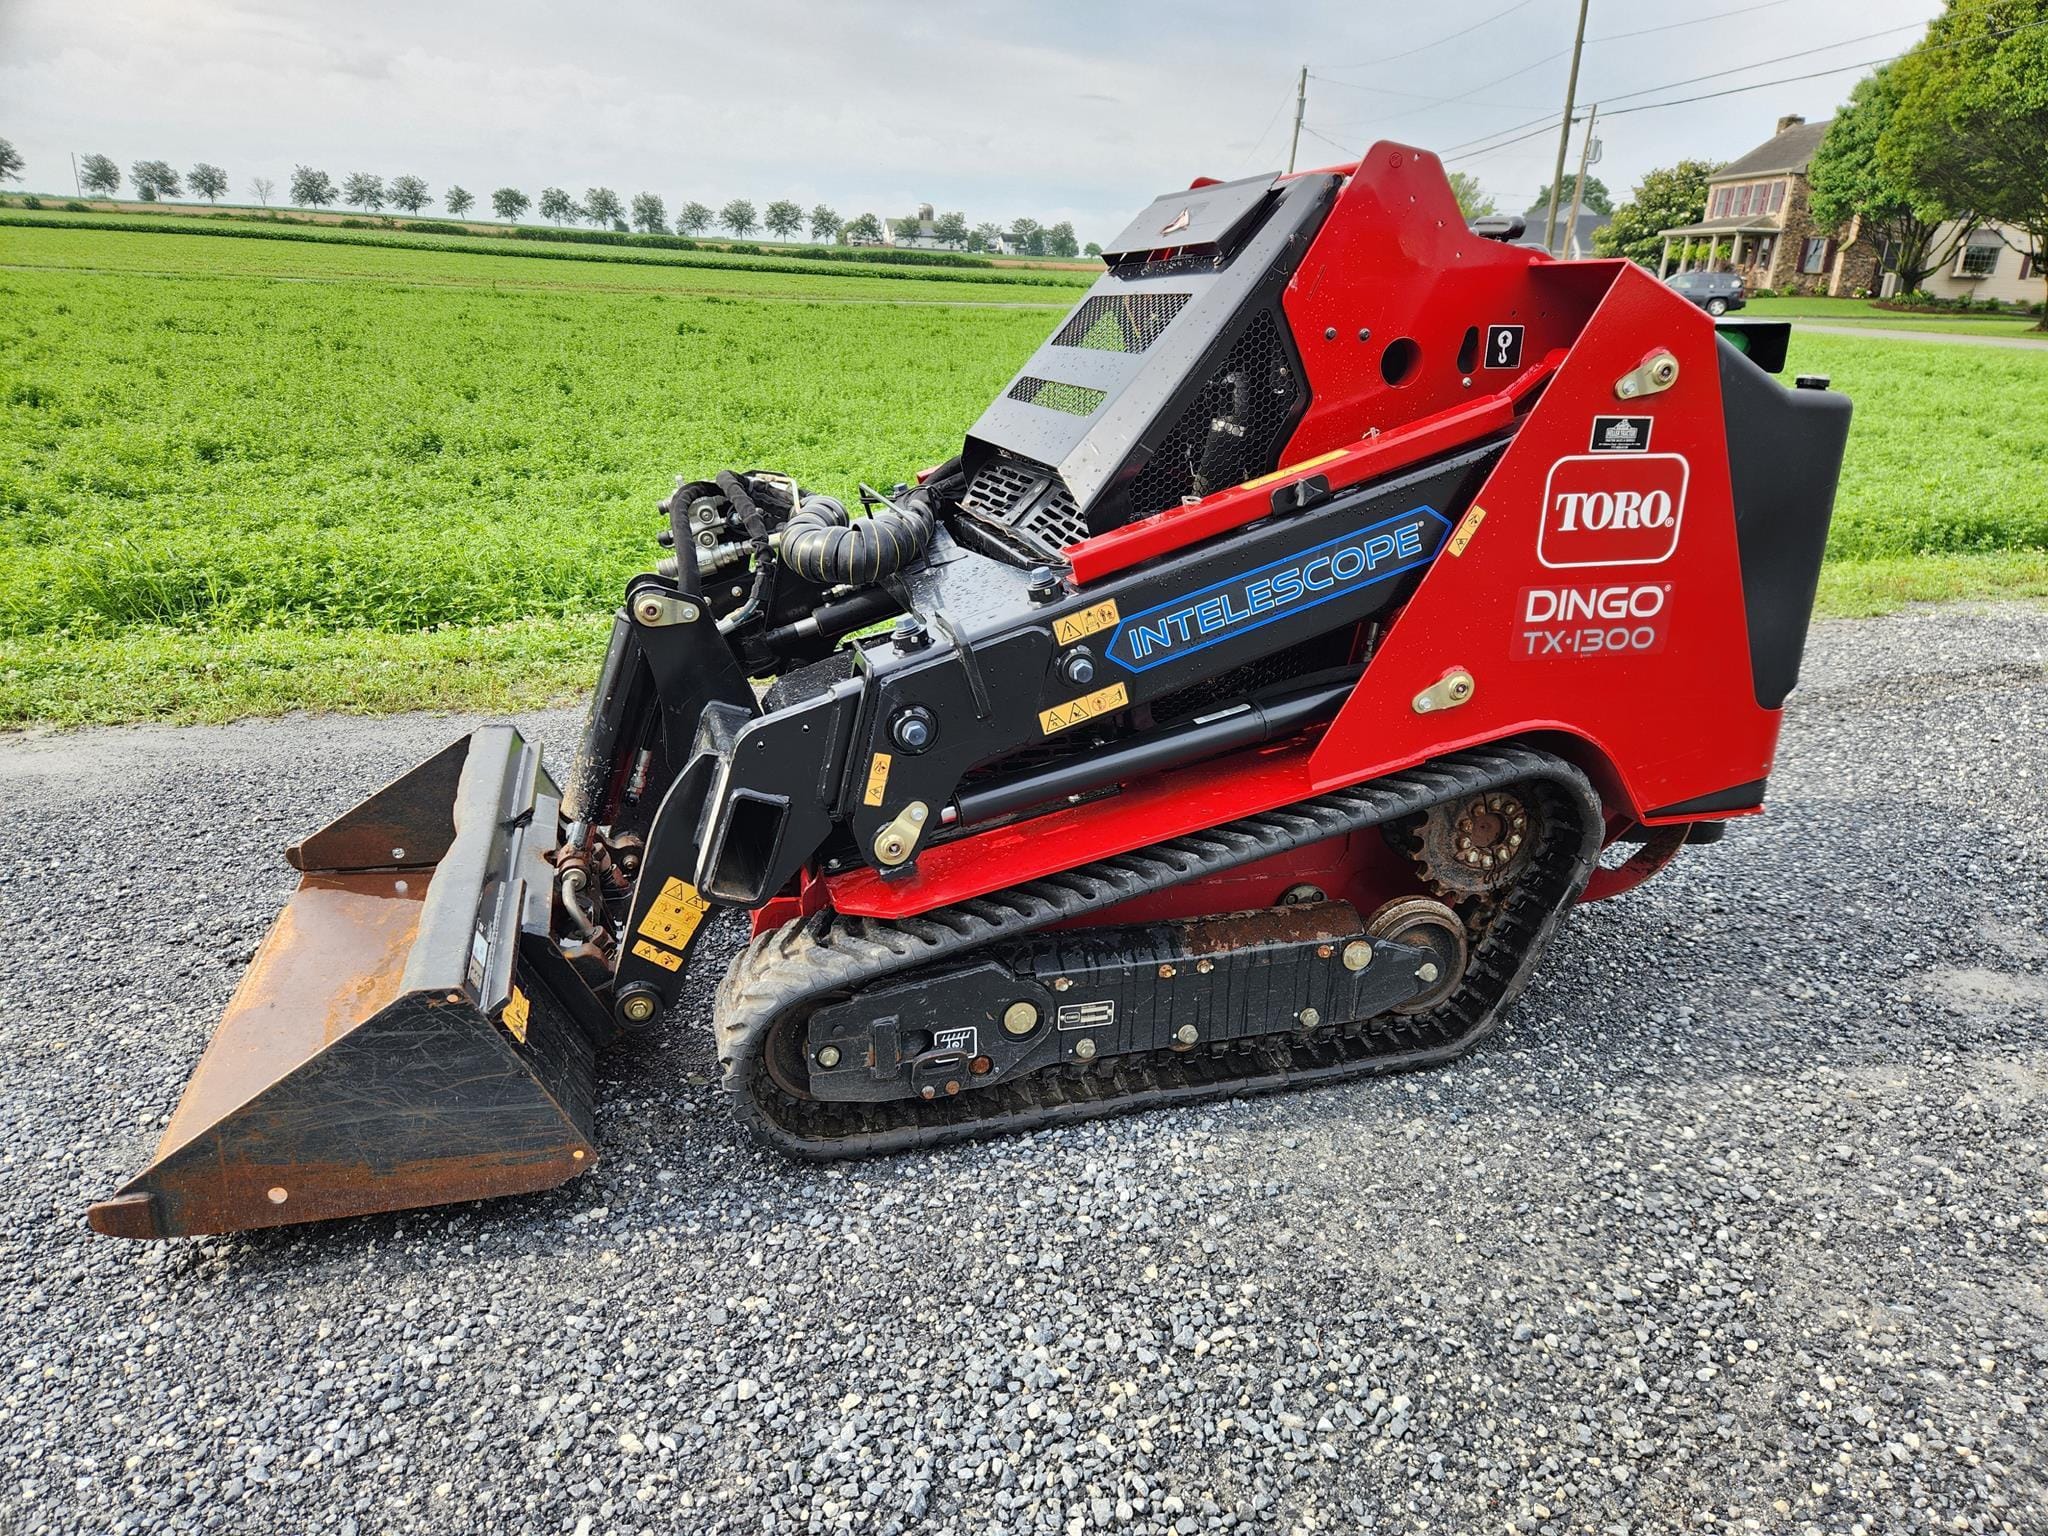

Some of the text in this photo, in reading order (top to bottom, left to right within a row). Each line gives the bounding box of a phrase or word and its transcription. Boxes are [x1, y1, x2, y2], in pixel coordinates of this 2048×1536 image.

[1556, 489, 1672, 531] TORO
[1128, 521, 1422, 659] INTELESCOPE
[1525, 586, 1664, 622] DINGO
